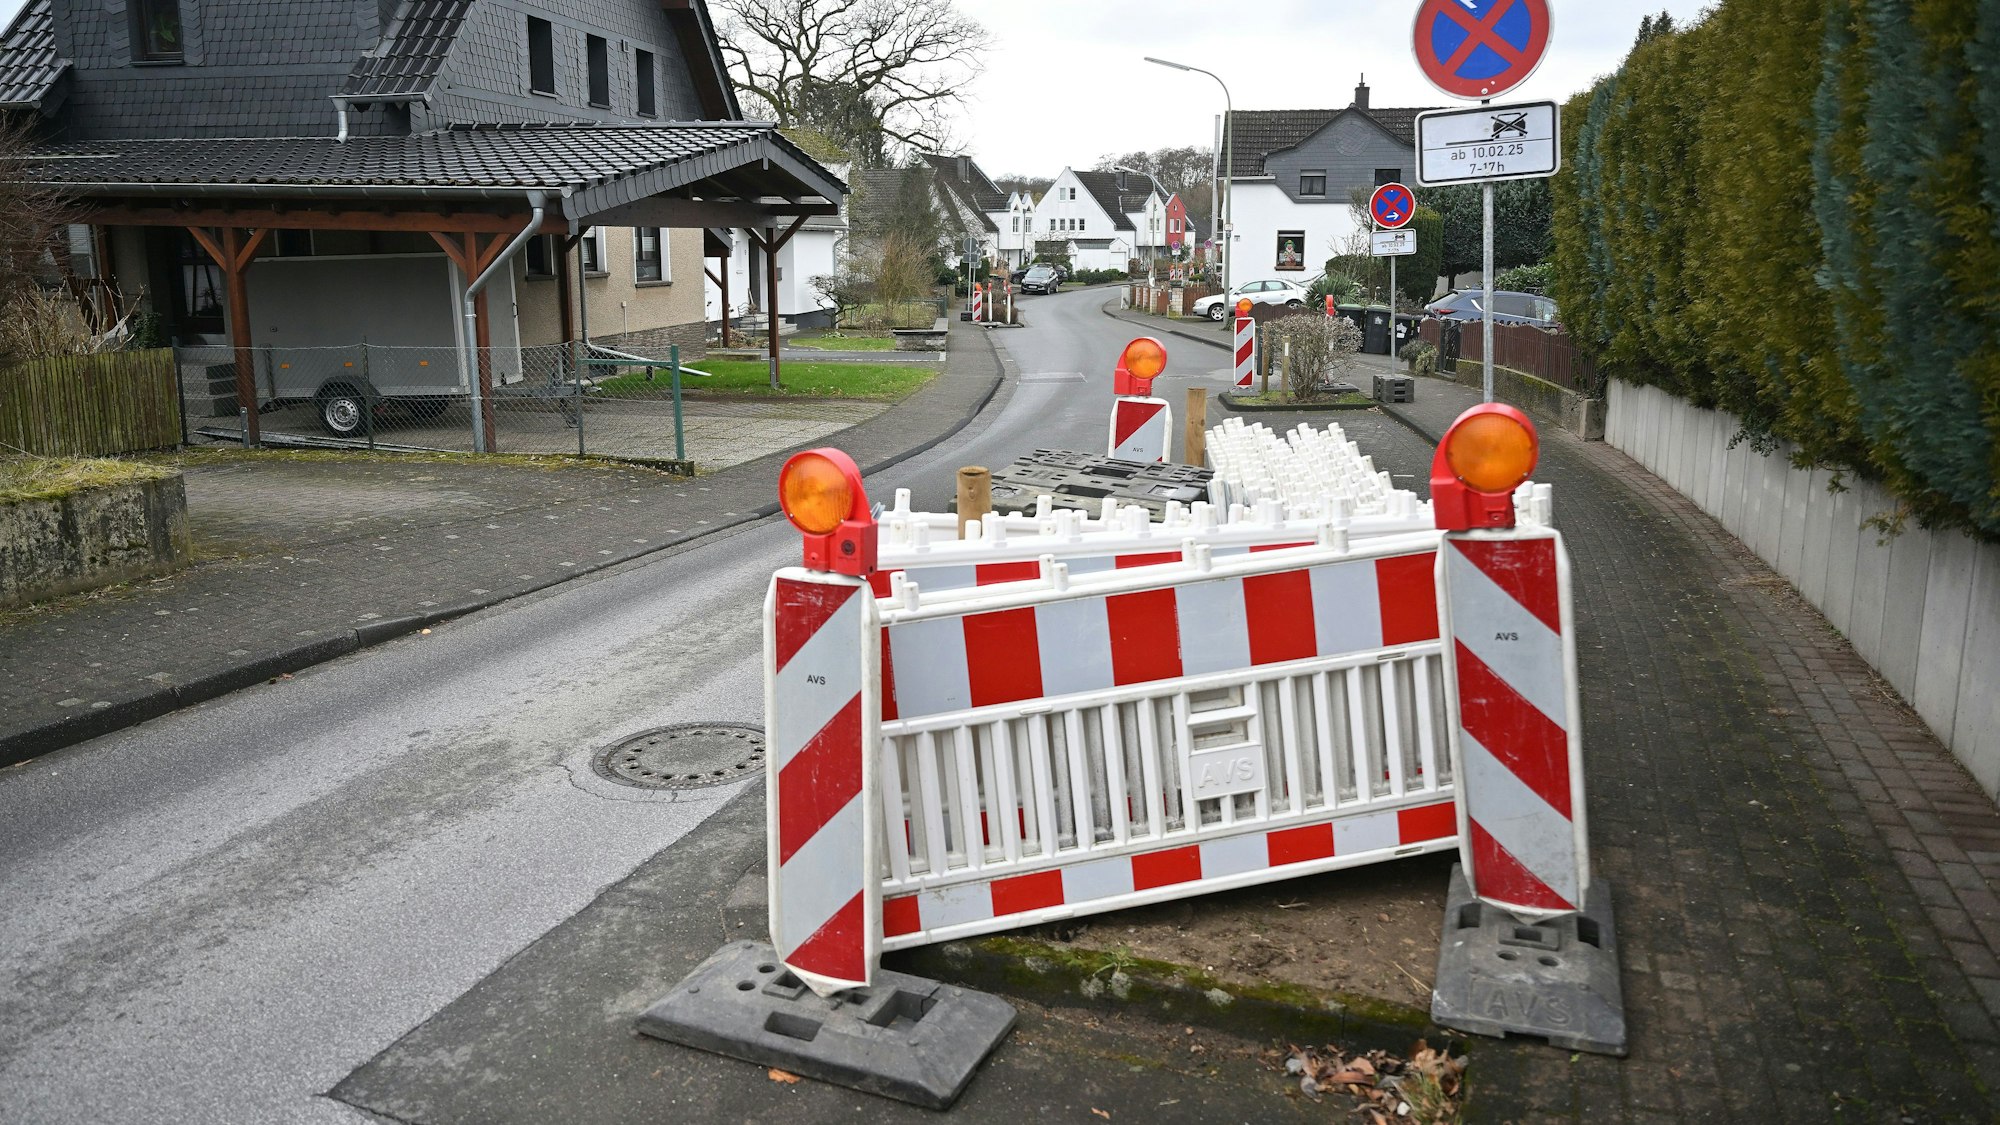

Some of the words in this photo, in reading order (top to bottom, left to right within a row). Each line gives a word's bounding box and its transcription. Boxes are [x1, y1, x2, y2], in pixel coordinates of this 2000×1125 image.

[1450, 149, 1466, 161] ab
[1472, 143, 1524, 159] 10.02.25
[1494, 632, 1519, 641] AVS
[806, 674, 826, 685] AVS
[1199, 757, 1254, 788] AVS
[1486, 988, 1571, 1026] AVS
